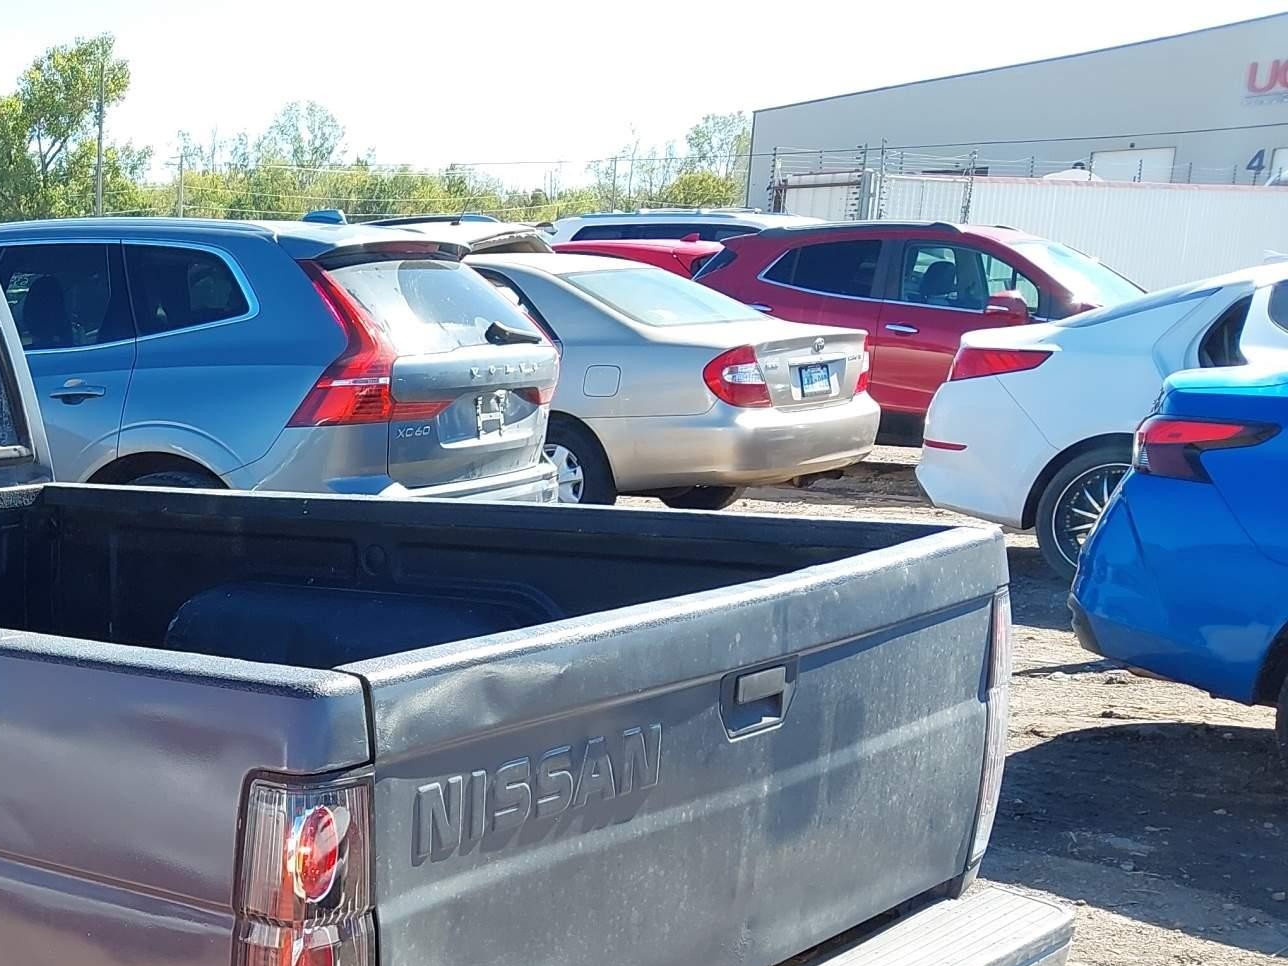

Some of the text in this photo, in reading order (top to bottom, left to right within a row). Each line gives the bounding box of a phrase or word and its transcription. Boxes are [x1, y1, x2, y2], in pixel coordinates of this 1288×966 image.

[1246, 149, 1266, 175] 4
[396, 425, 431, 440] XC60
[412, 722, 663, 866] NISSAN
